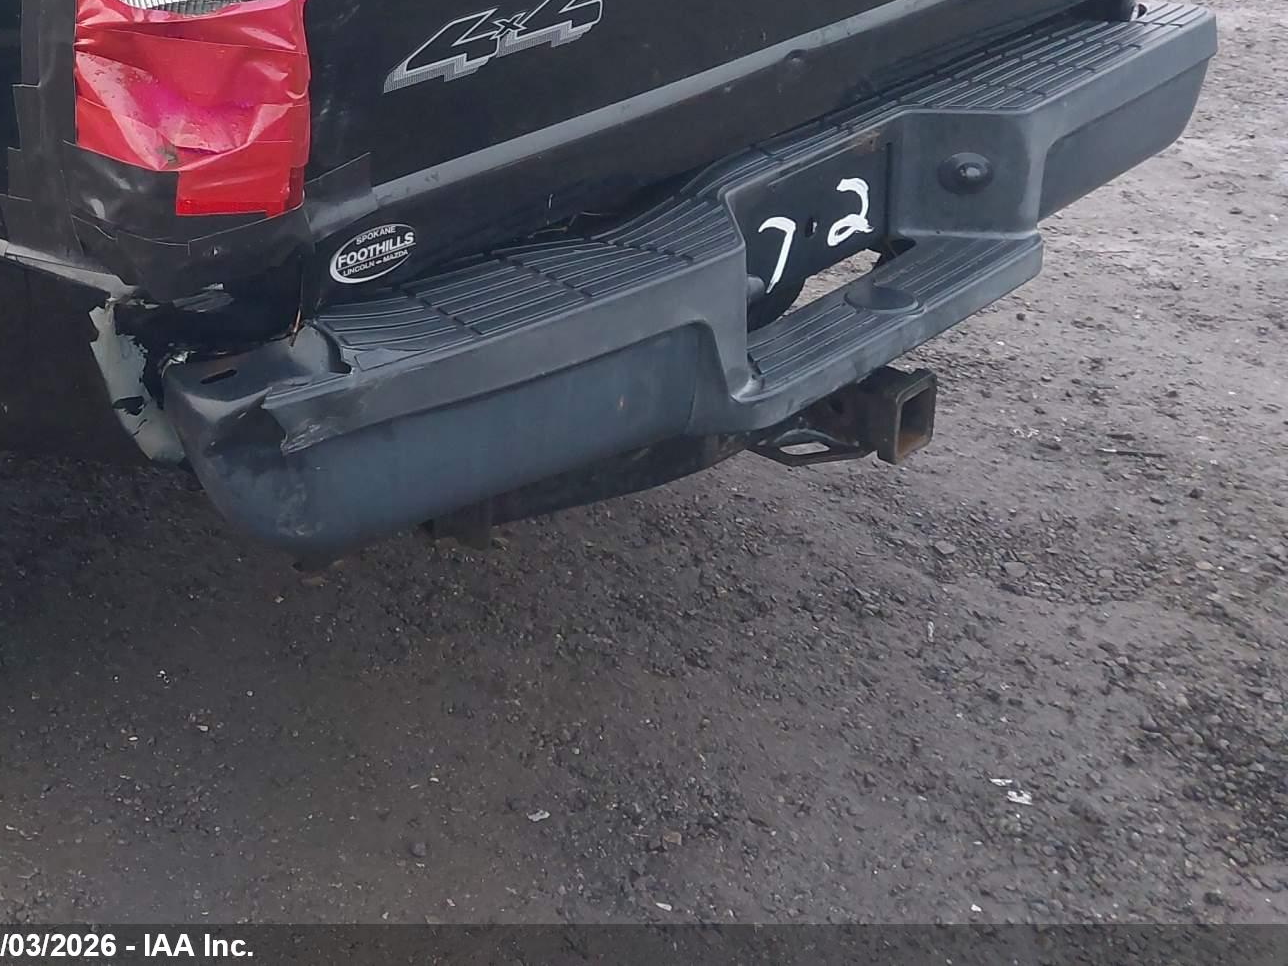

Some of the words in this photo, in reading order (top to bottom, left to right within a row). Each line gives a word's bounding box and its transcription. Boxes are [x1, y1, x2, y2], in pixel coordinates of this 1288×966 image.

[355, 225, 397, 245] SPOKANE
[337, 231, 415, 269] FOOTHILLS
[342, 260, 375, 277] LINCOLN
